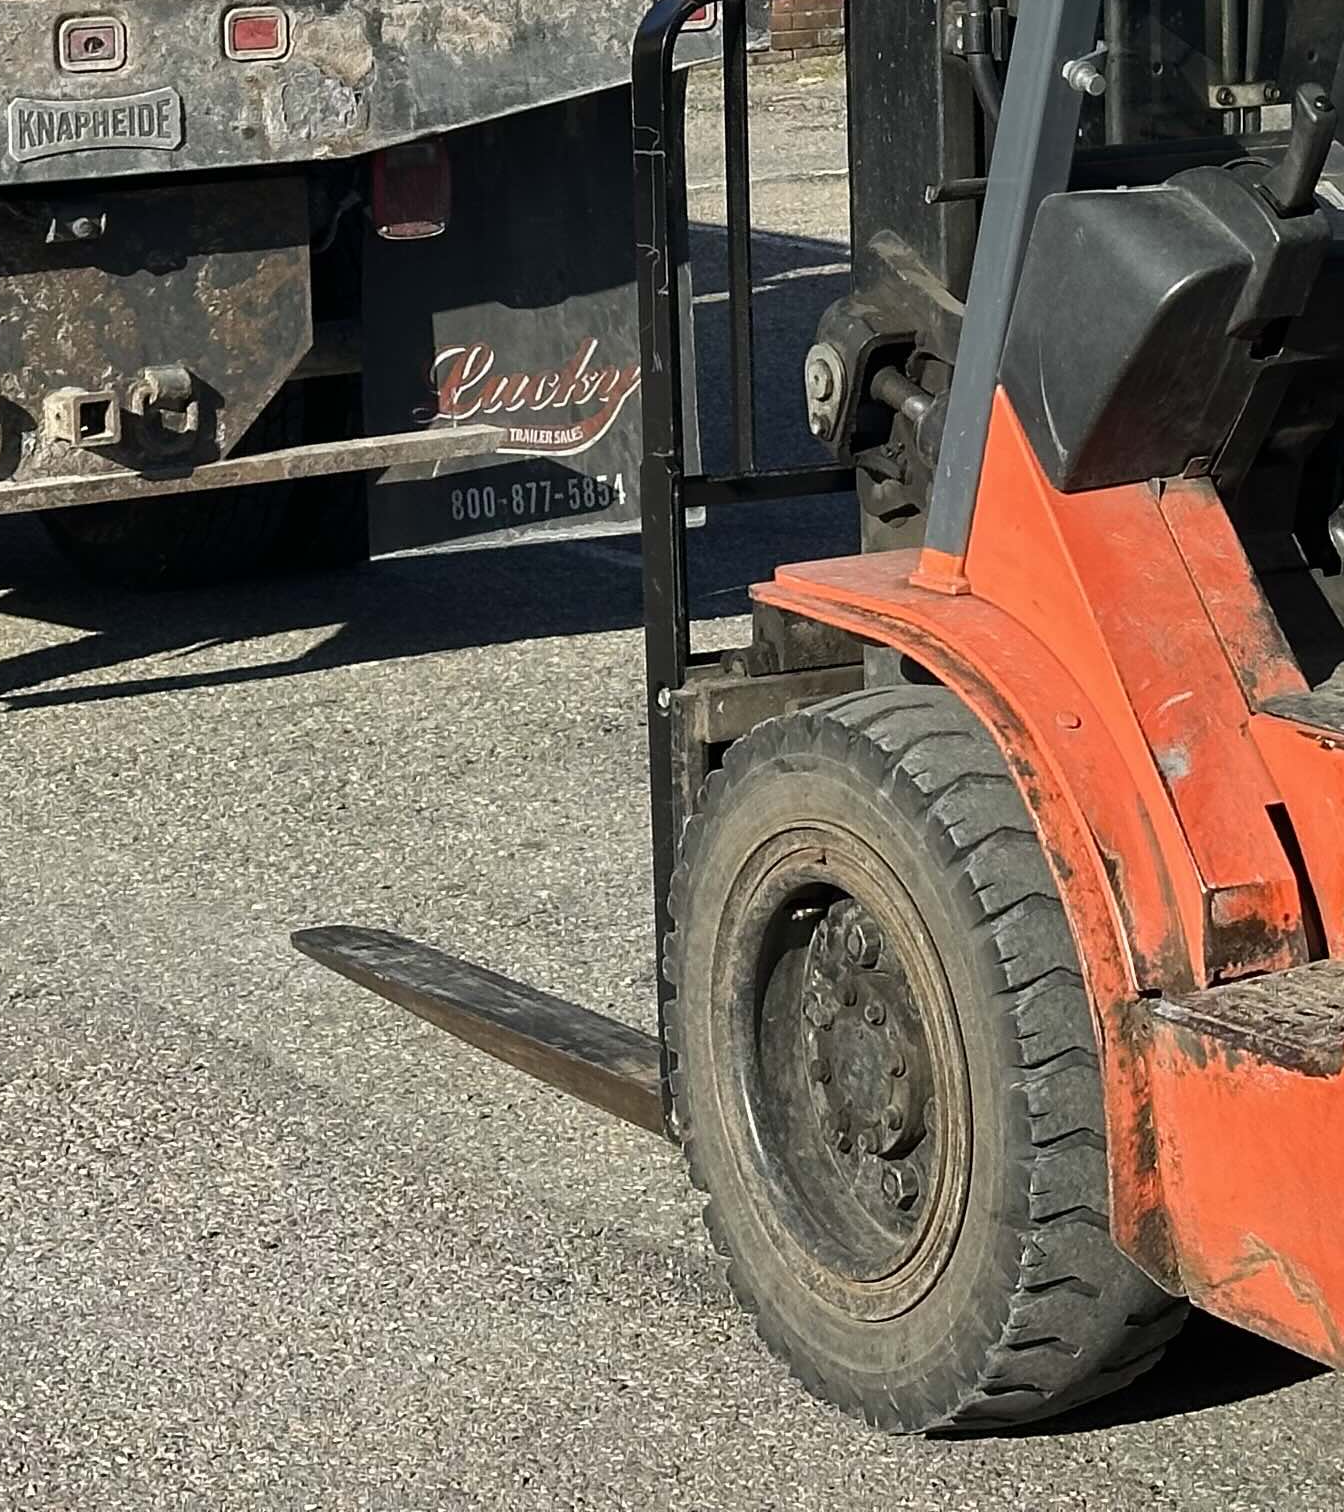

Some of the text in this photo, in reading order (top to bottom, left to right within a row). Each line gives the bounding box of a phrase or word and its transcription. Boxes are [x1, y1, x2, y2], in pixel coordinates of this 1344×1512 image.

[18, 98, 172, 150] KNAPHEIDE
[509, 426, 584, 444] TRAILER SALES
[451, 473, 627, 520] 800-877-5854
